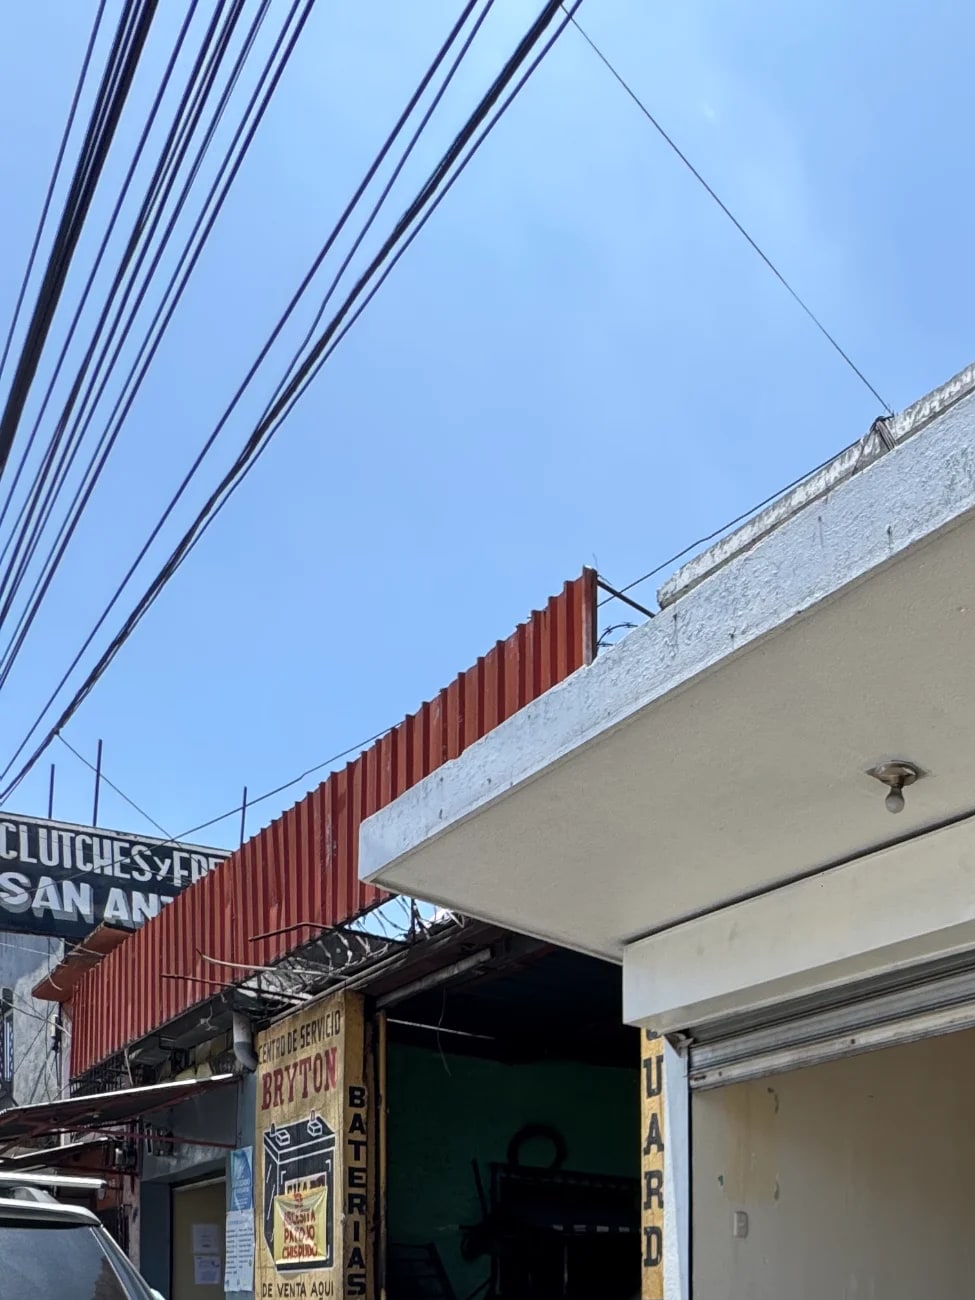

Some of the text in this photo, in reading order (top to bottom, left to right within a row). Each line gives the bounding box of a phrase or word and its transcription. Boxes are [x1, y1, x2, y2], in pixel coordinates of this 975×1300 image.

[0, 822, 153, 882] CLUTCHES
[0, 871, 174, 923] SAN AN
[258, 1009, 341, 1065] CENTRO DE SERVICIO
[261, 1046, 338, 1111] BRYTON
[643, 1027, 664, 1268] UARD
[347, 1085, 368, 1297] BATERIAS
[262, 1280, 334, 1300] DE VENTA AQUI
